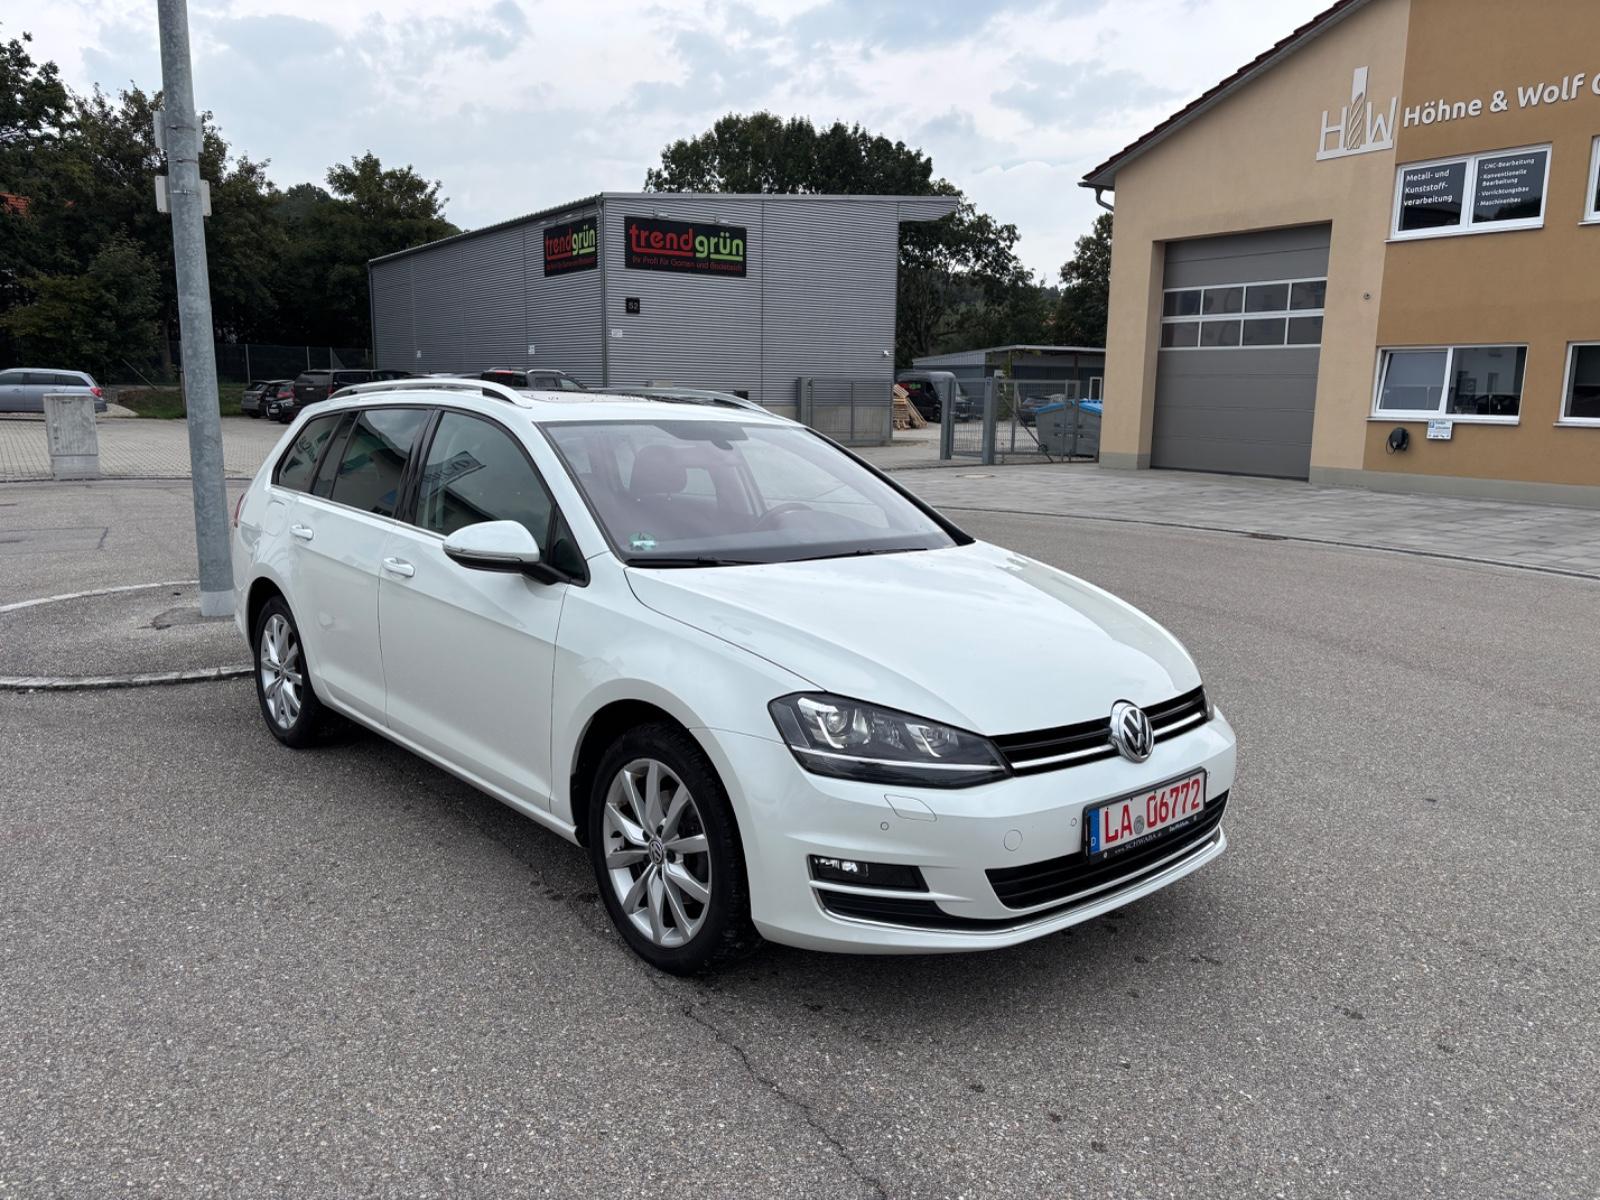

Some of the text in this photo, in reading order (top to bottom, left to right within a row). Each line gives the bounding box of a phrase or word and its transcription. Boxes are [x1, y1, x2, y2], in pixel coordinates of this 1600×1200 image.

[1403, 98, 1482, 128] Höhne
[1489, 90, 1508, 113] &
[1517, 73, 1586, 108] Wolf
[1435, 169, 1450, 178] und
[1404, 195, 1453, 206] verarbeitung
[1104, 778, 1200, 843] LA 06772
